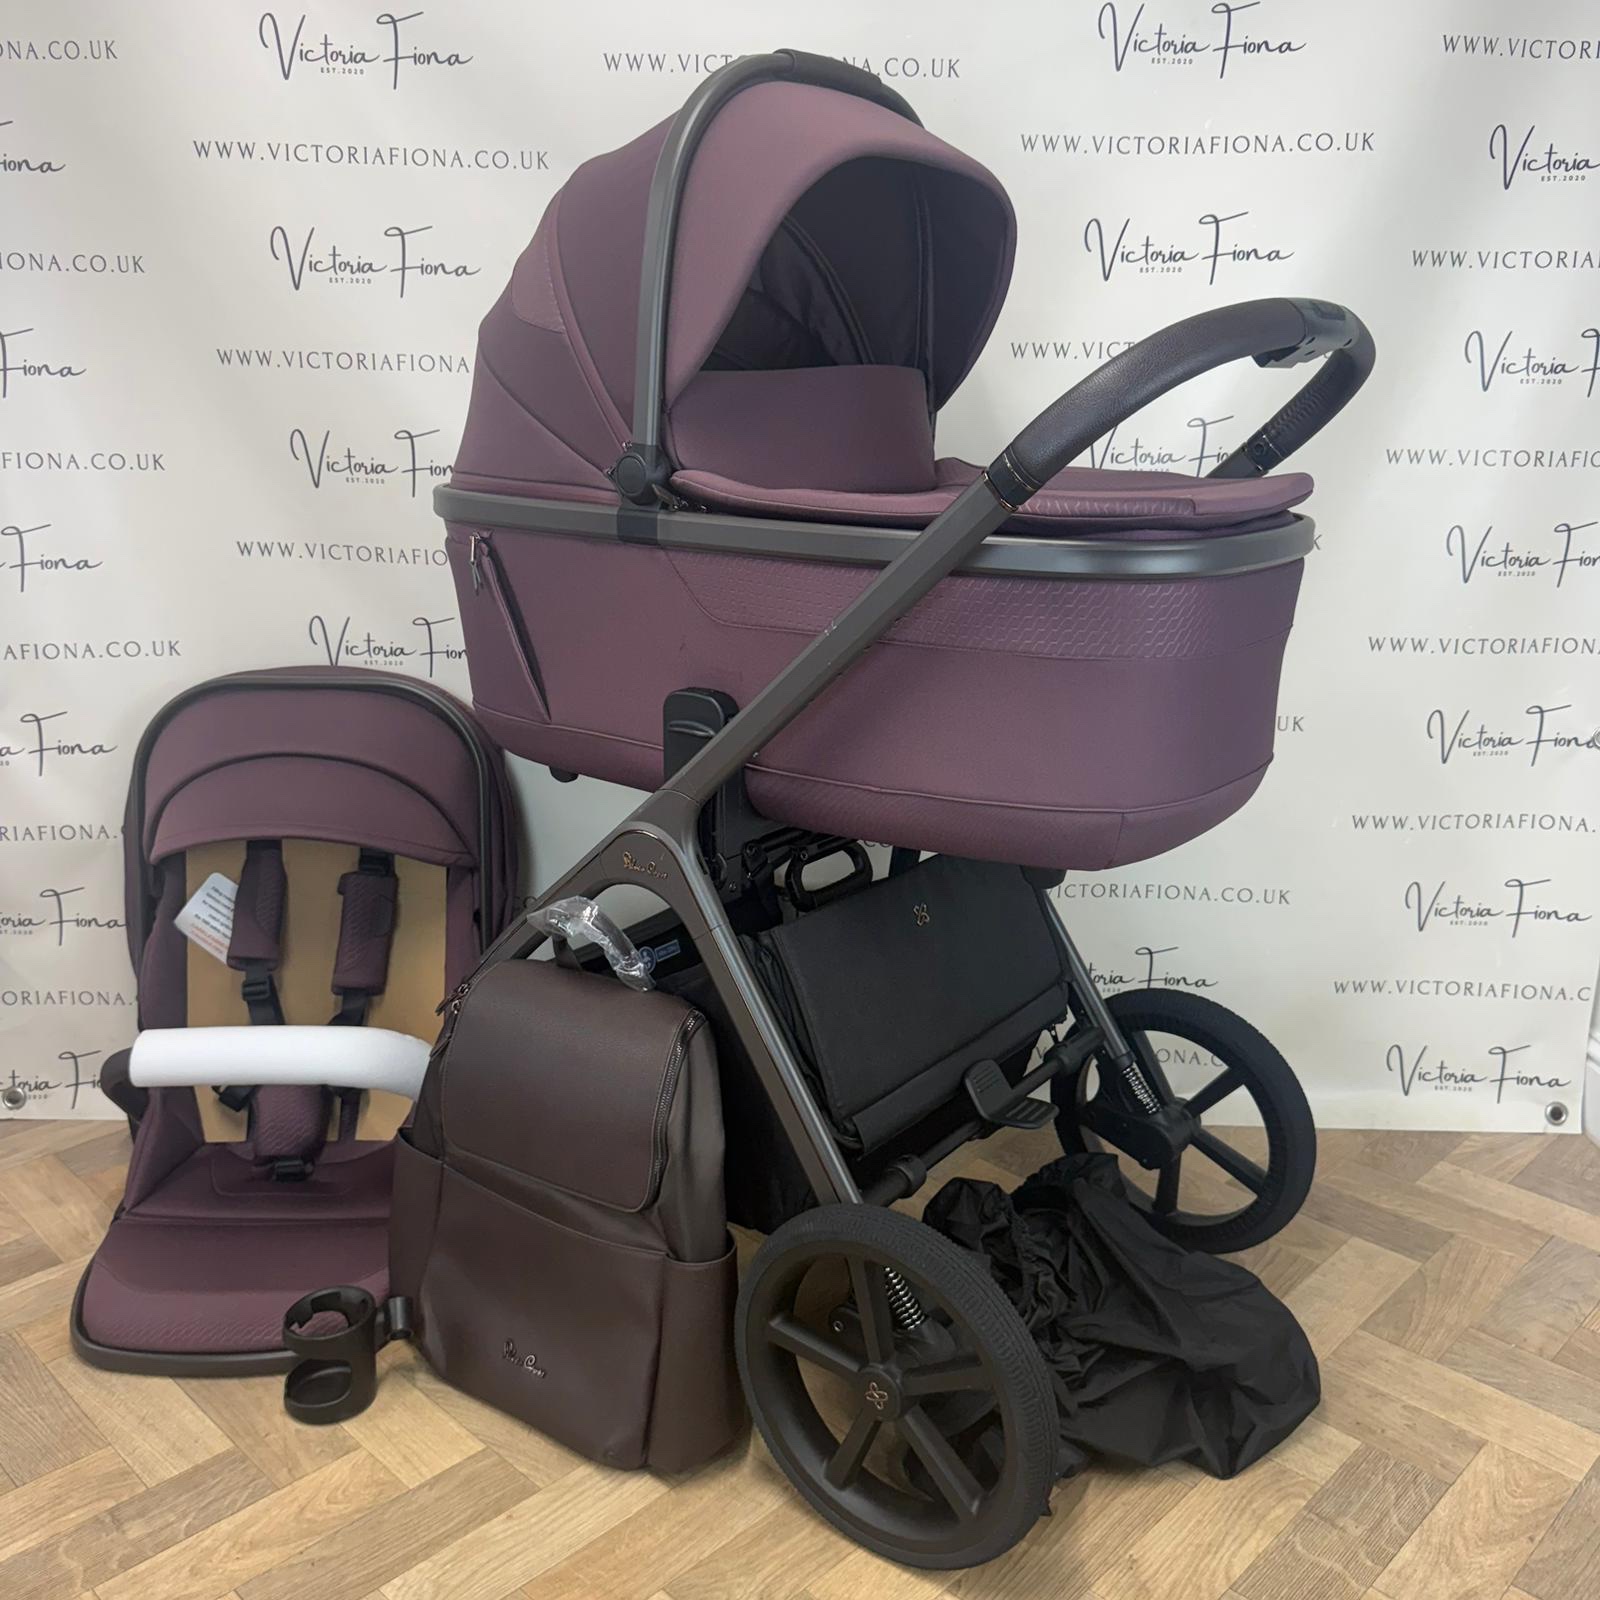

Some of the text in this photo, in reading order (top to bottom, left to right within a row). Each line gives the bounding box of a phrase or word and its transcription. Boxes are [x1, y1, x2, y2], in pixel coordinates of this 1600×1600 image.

[259, 11, 473, 90] Victoria Fiona
[1098, 1, 1307, 79] Victoria Fiona
[320, 67, 364, 75] EST.2020
[0, 120, 66, 174] iona
[193, 140, 549, 169] WWW.VICTORIAFIONA.CO.UK
[1021, 132, 1374, 155] WWW.VICTORIAFIONA.CO.UK
[1489, 124, 1600, 190] Victoria
[270, 226, 481, 298] Victoria Fiona
[1084, 211, 1295, 285] Victoria Fiona
[1413, 250, 1600, 269] WWW.VICTORIA
[216, 349, 469, 373] WWW.VICTORIAFIONA
[1464, 330, 1579, 392] Victoria
[2, 452, 165, 471] FIONA.CO.UK
[290, 429, 399, 490] Victoria
[1, 524, 103, 593] Fiona
[1446, 525, 1551, 584] Victoria
[4, 640, 181, 660] AFIONA.CO.UK
[309, 615, 417, 673] Victoria
[1368, 636, 1600, 655] WWW.VICTORIAFION
[20, 712, 118, 777] Fiona
[1427, 709, 1525, 765] Victoria
[39, 887, 126, 946] Fiona
[1405, 879, 1592, 938] Victoria Fiona
[1135, 946, 1219, 988] Fiona
[1386, 1044, 1571, 1104] Victoria Fiona
